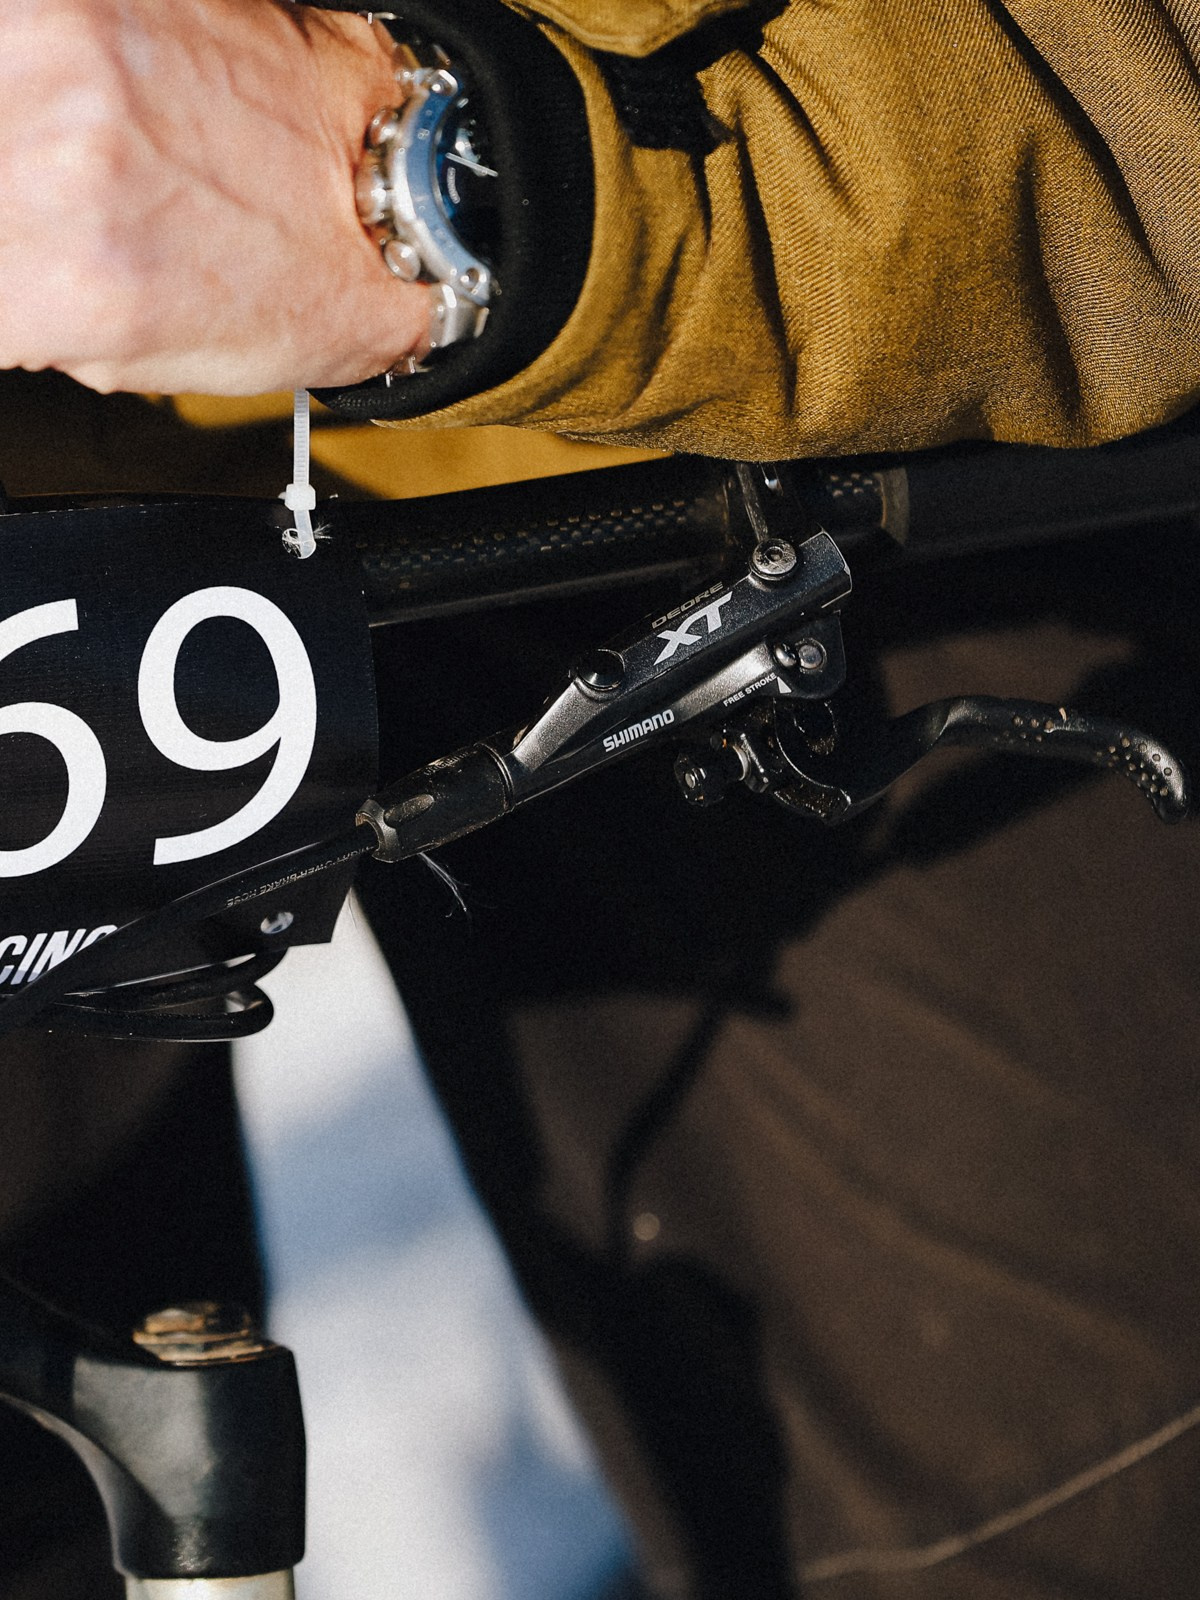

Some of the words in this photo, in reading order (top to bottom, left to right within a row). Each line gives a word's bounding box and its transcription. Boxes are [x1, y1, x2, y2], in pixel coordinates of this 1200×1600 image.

[652, 581, 724, 629] DEORE
[653, 591, 733, 666] XT
[722, 691, 746, 707] FREE
[744, 672, 777, 695] STROKE
[603, 709, 675, 752] SHIMANO
